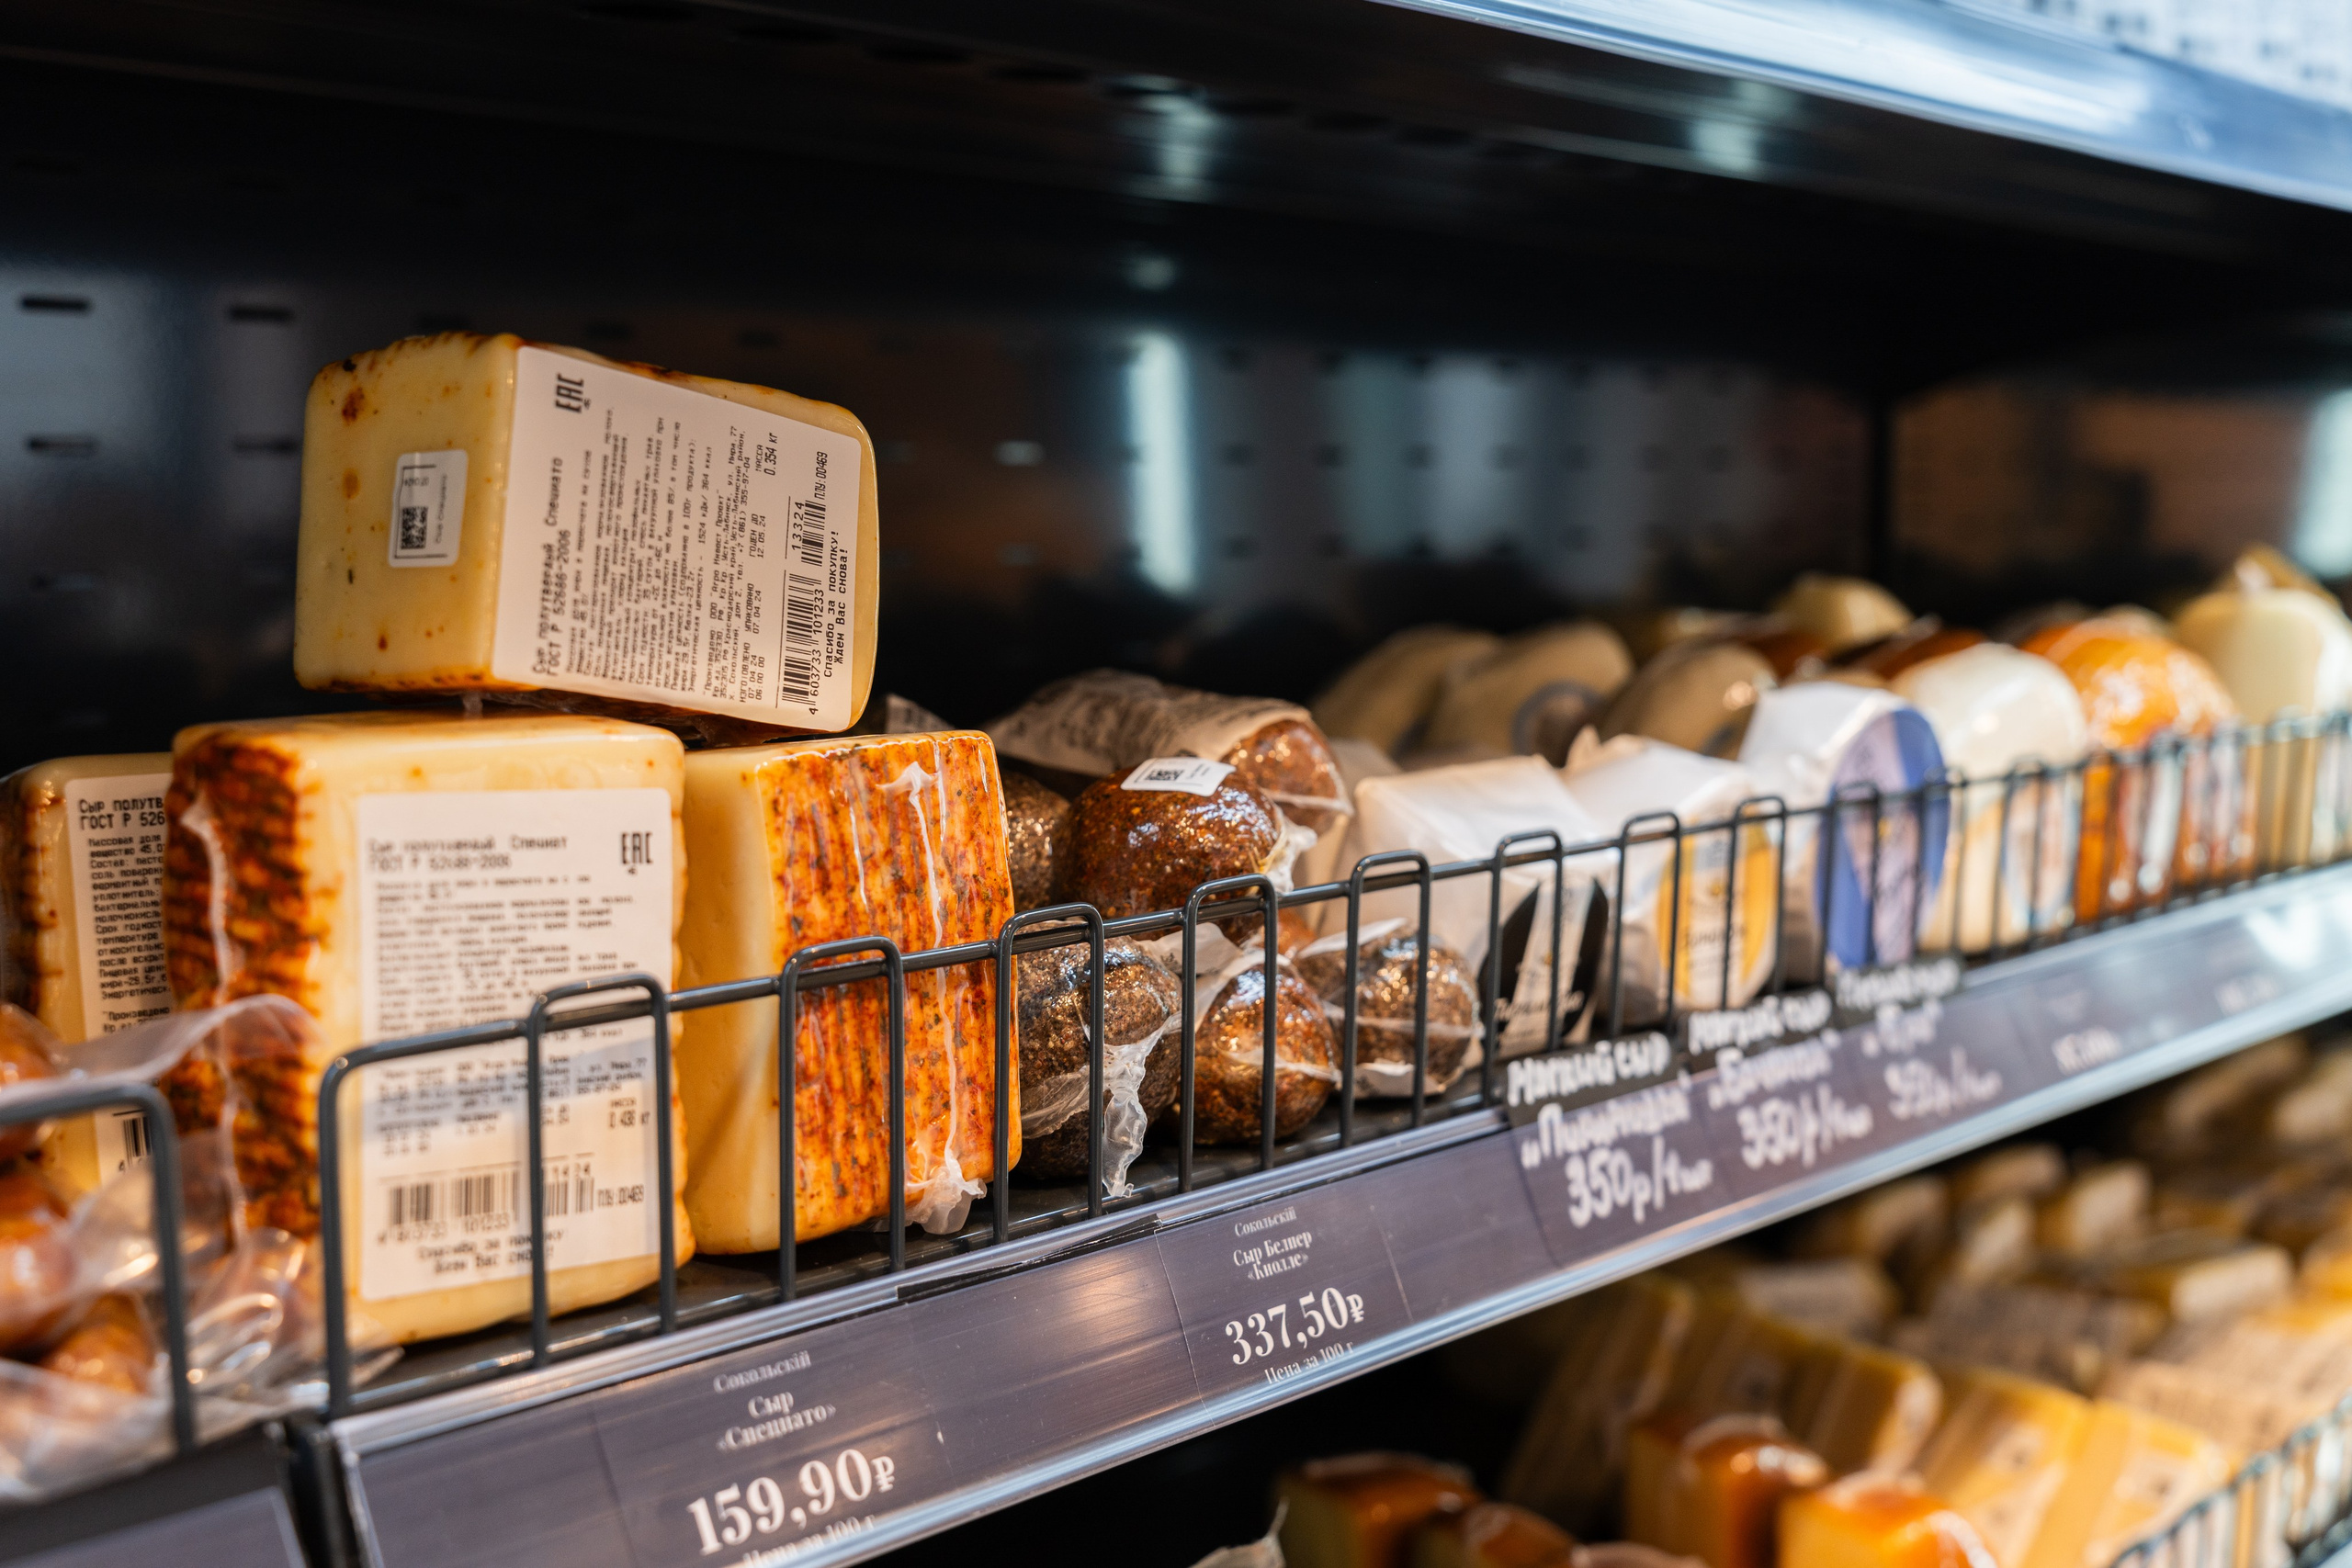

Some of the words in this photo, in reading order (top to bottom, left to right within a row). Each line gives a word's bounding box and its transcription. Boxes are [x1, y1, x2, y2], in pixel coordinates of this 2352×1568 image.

[656, 416, 664, 434] при
[673, 421, 681, 450] числе
[768, 431, 777, 444] кг
[652, 438, 662, 484] упаковке
[754, 443, 763, 472] МАССА
[763, 446, 776, 476] 0.354
[701, 472, 709, 491] 364
[740, 456, 751, 506] 355-97-04
[814, 449, 828, 500] ПЛУ:00469
[697, 521, 707, 544] 1524
[738, 510, 746, 538] (861)
[751, 513, 759, 525] ДО
[791, 501, 804, 552] 13324
[713, 532, 722, 565] Инвест
[748, 529, 757, 558] ГОДЕН
[756, 514, 765, 558] 12.05.24
[552, 527, 571, 615] 52686-2006
[654, 568, 661, 579] до
[828, 529, 839, 592] покупку!
[837, 547, 848, 594] снова!
[695, 565, 704, 610] ценность
[709, 602, 718, 619] ООО
[744, 581, 754, 632] УПАКОВАНО
[752, 589, 762, 634] 07.04.24
[812, 587, 824, 636] 101233
[827, 599, 835, 615] за
[835, 600, 845, 626] Вас
[550, 623, 563, 633] Р
[666, 611, 675, 654] вскрытия
[675, 601, 684, 646] ценность
[532, 646, 547, 674] Сыр
[547, 641, 561, 677] ГОСТ
[823, 621, 834, 678] Спасибо
[833, 631, 844, 664] Ждем
[636, 661, 645, 684] Срок
[748, 654, 757, 698] 07.04.24
[755, 655, 764, 700] 06:00:00
[809, 648, 821, 697] 603733
[808, 706, 819, 716] 4
[79, 799, 105, 814] Сыр
[80, 813, 114, 830] ГОСТ
[122, 812, 132, 827] Р
[88, 836, 134, 847] Массовая
[140, 835, 162, 845] доля
[140, 843, 165, 854] 45.0
[91, 871, 115, 880] соль
[96, 924, 118, 935] Срок
[97, 931, 158, 945] температуре
[99, 957, 127, 966] после
[99, 967, 139, 978] Пищевая
[102, 987, 171, 999] Энергетическ
[1233, 1247, 1262, 1267] Сыр
[1264, 1231, 1312, 1258] Белпер
[1225, 1287, 1365, 1366] 337,50₽
[1264, 1361, 1303, 1385] Цена
[1303, 1355, 1319, 1370] за
[1319, 1342, 1345, 1363] 100
[748, 1391, 794, 1419] Сыр
[686, 1449, 896, 1555] 159,90₽
